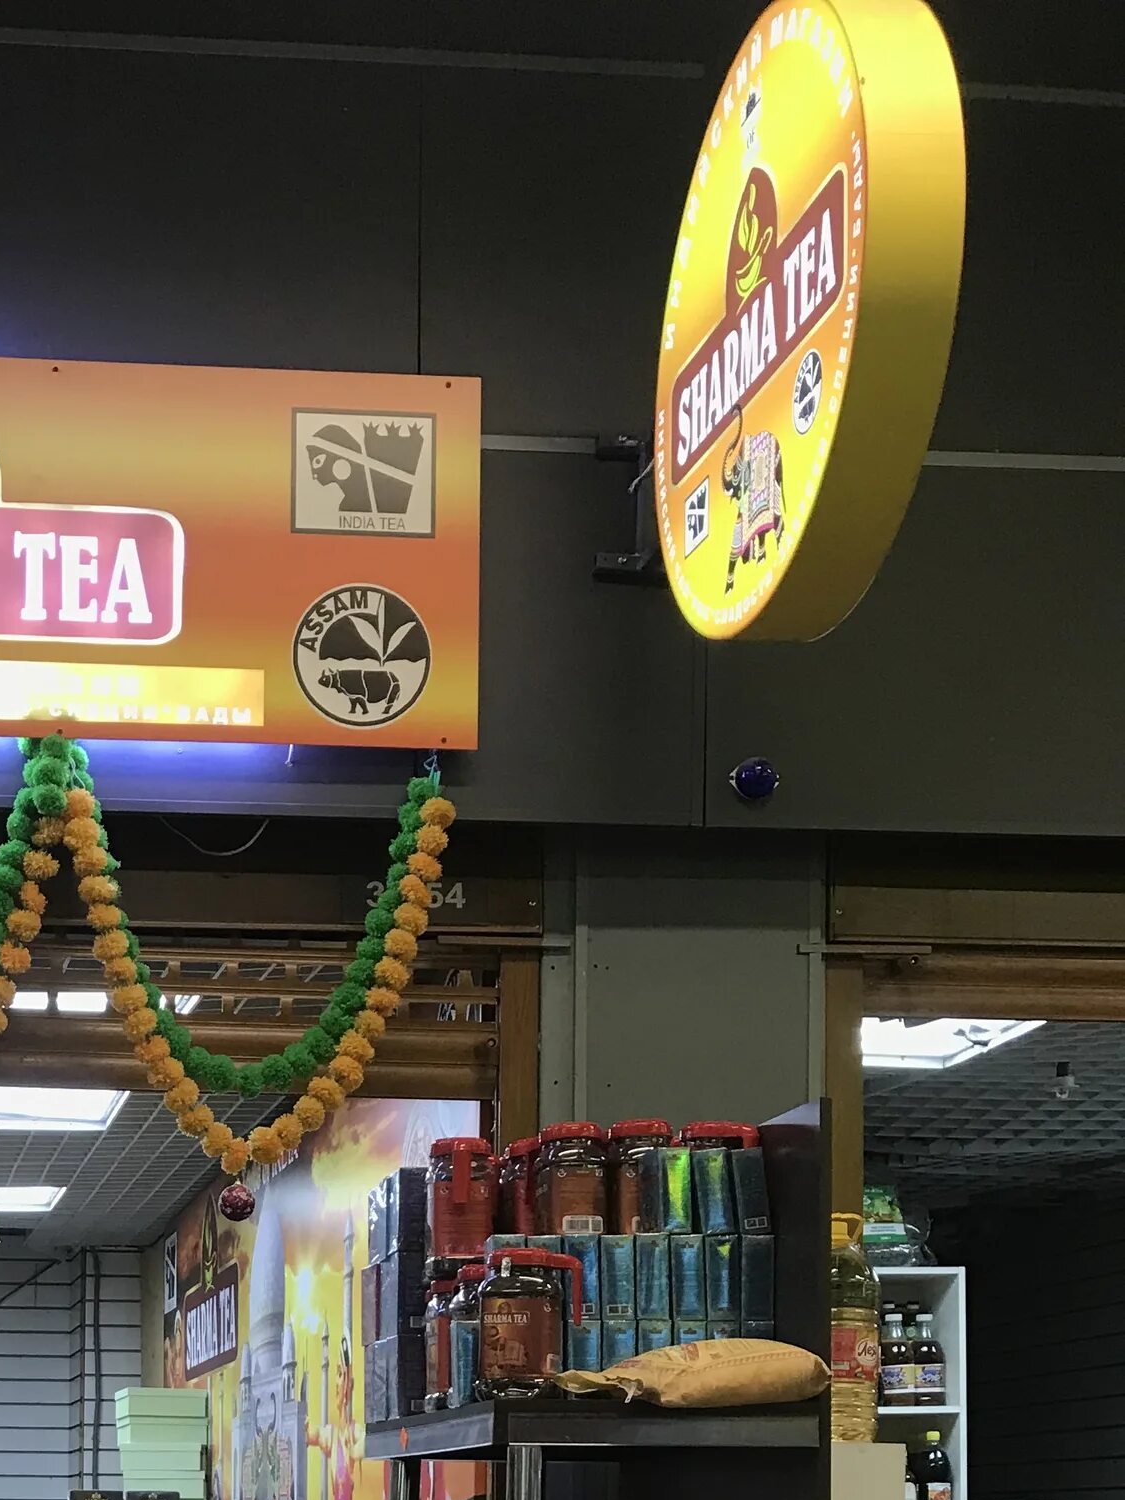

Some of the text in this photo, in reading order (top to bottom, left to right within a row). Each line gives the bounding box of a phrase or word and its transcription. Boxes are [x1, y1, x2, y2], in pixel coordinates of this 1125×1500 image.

[664, 7, 853, 350] ИНДИЙСКИЙ МАГАЗИН
[676, 282, 778, 468] SHARMA
[783, 208, 836, 342] TEA
[338, 514, 406, 531] INDIA TEA
[13, 530, 154, 625] TEA
[298, 588, 370, 654] ASSAM
[365, 881, 466, 909] 354
[186, 1283, 236, 1371] SHARMA TEA
[484, 1313, 527, 1324] SHARMA TEA
